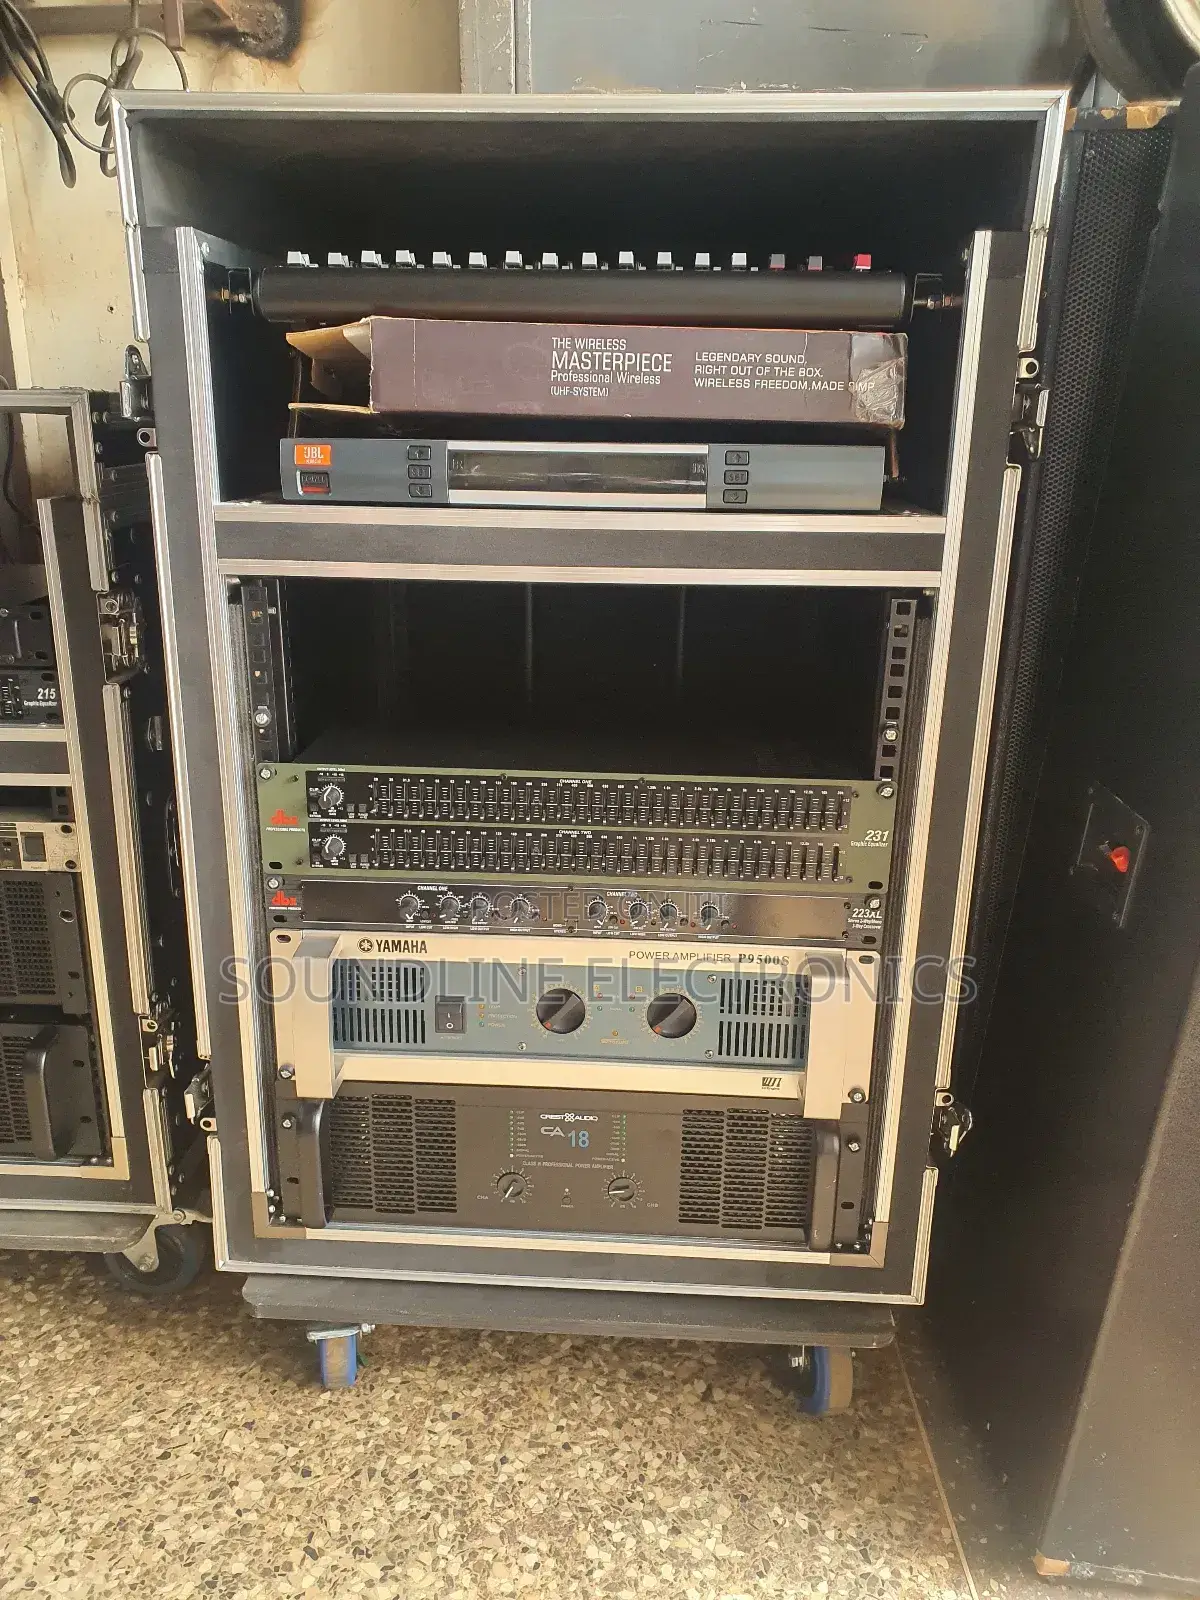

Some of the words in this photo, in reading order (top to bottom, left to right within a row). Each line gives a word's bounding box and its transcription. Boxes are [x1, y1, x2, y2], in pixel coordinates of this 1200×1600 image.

[551, 337, 571, 349] THE
[574, 338, 627, 351] WIRELESS
[552, 351, 673, 373] MASTERPIECE
[695, 352, 762, 363] LEGENDARY
[551, 370, 613, 384] Professional
[616, 372, 661, 385] Wireless
[694, 365, 728, 375] RIGHT
[730, 366, 752, 376] OUT
[756, 367, 771, 376] OF
[774, 367, 796, 377] THE
[694, 378, 751, 389] WIRELESS
[550, 386, 609, 397] (UHF-SYSTEM)
[304, 446, 324, 459] JBL
[37, 687, 56, 700] 215
[864, 829, 889, 842] 231
[271, 890, 297, 906] dbx
[375, 939, 428, 954] YAMAHA
[629, 950, 670, 960] POWER
[673, 952, 731, 962] AMPLIFIER
[738, 953, 790, 966] P9500S
[540, 1126, 565, 1137] CA
[567, 1130, 590, 1148] 18
